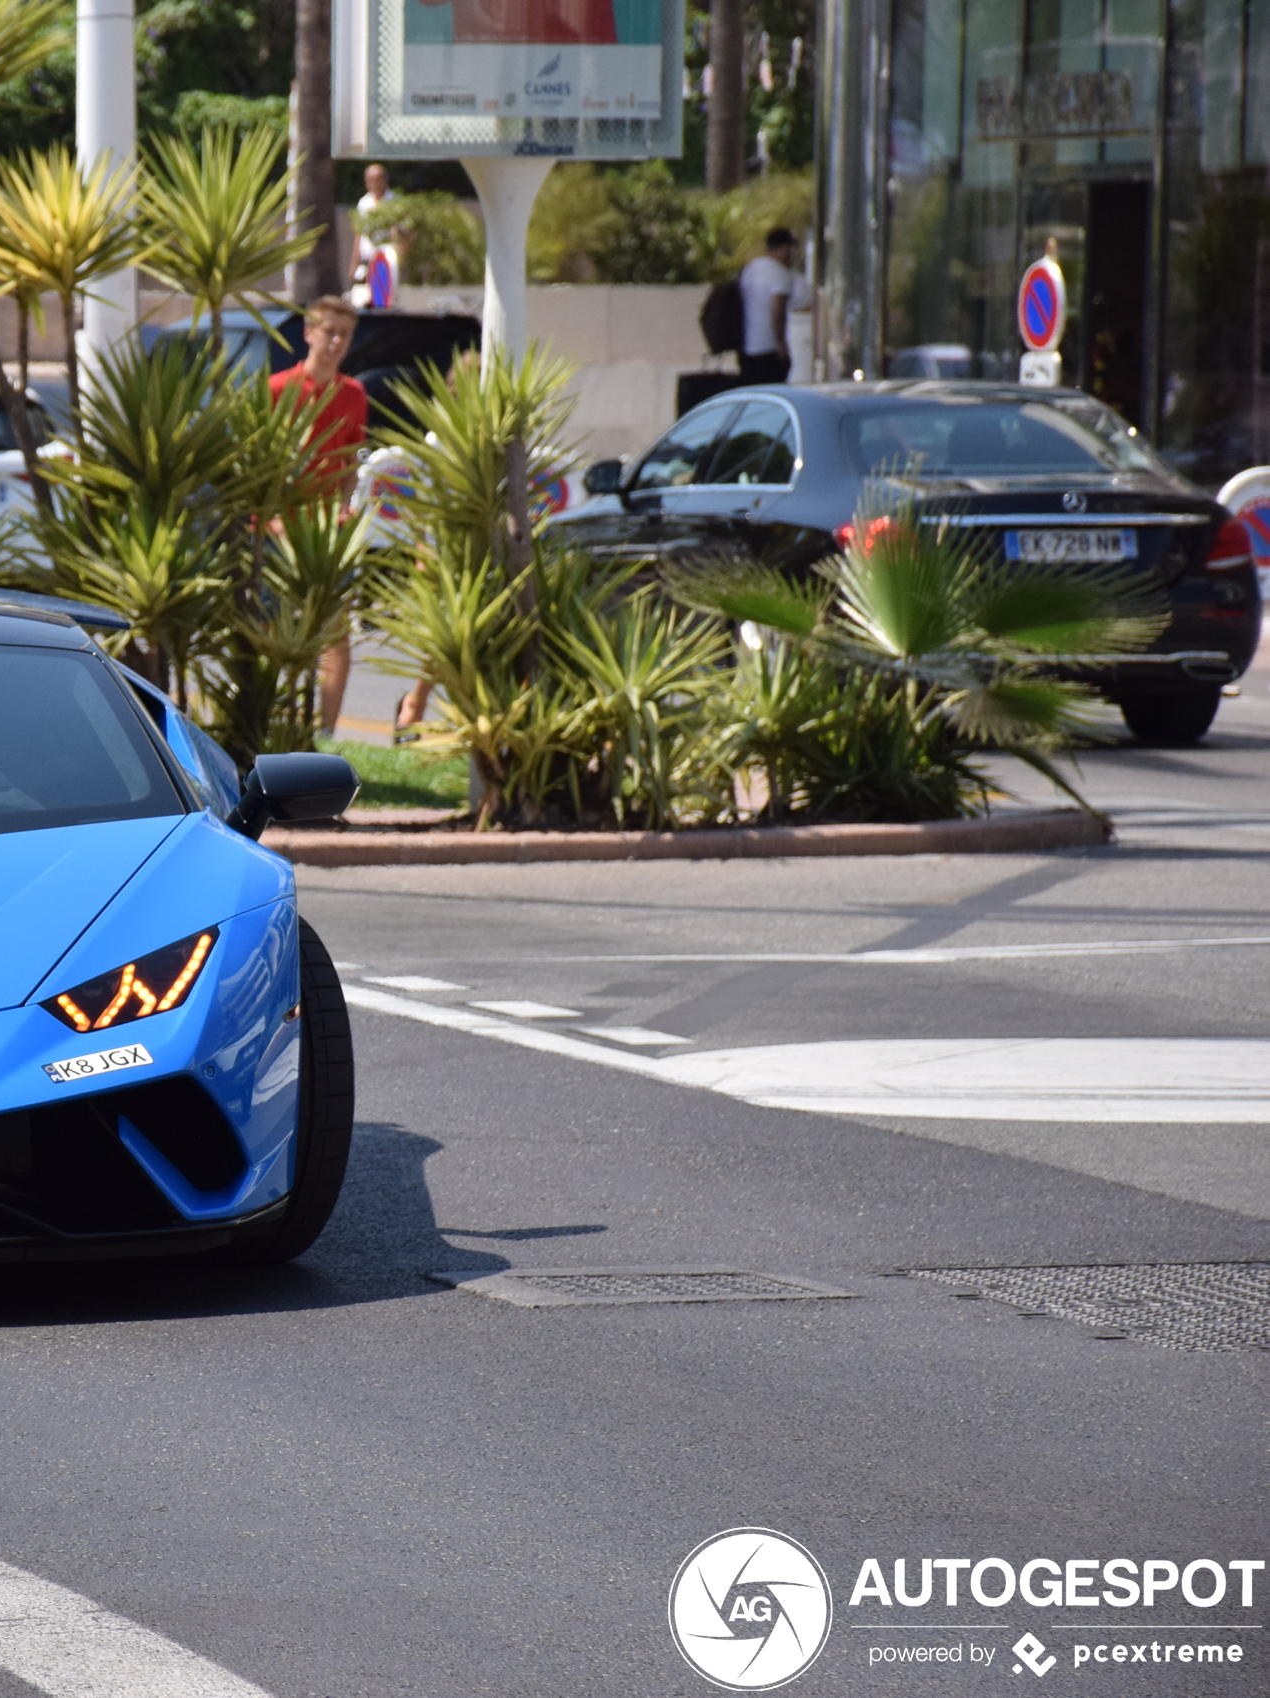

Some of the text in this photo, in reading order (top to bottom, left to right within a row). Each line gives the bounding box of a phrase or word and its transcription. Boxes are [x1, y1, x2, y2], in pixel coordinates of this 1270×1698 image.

[524, 81, 571, 96] CANNES
[58, 1047, 147, 1078] K8 JGX
